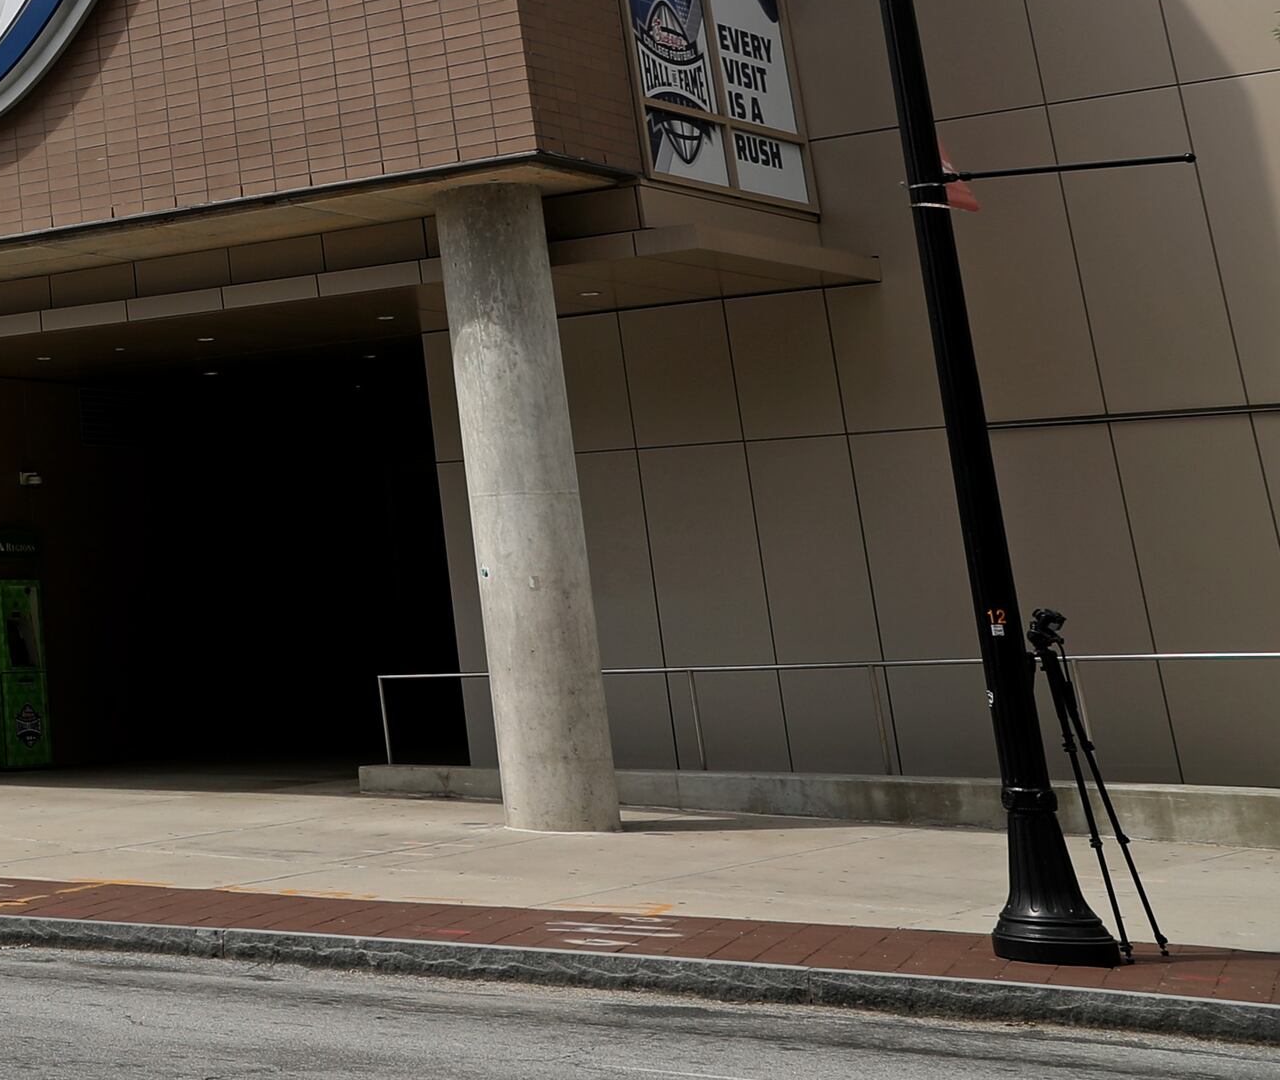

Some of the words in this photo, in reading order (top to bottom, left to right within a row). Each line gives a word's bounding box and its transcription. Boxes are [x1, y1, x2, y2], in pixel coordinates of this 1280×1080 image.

[717, 23, 772, 63] EVERY
[642, 49, 673, 92] HALL
[678, 64, 707, 106] FAME
[721, 56, 767, 93] VISIT
[727, 90, 747, 120] IS
[751, 96, 765, 124] A
[734, 132, 783, 170] RUSH
[986, 609, 1007, 624] 12
